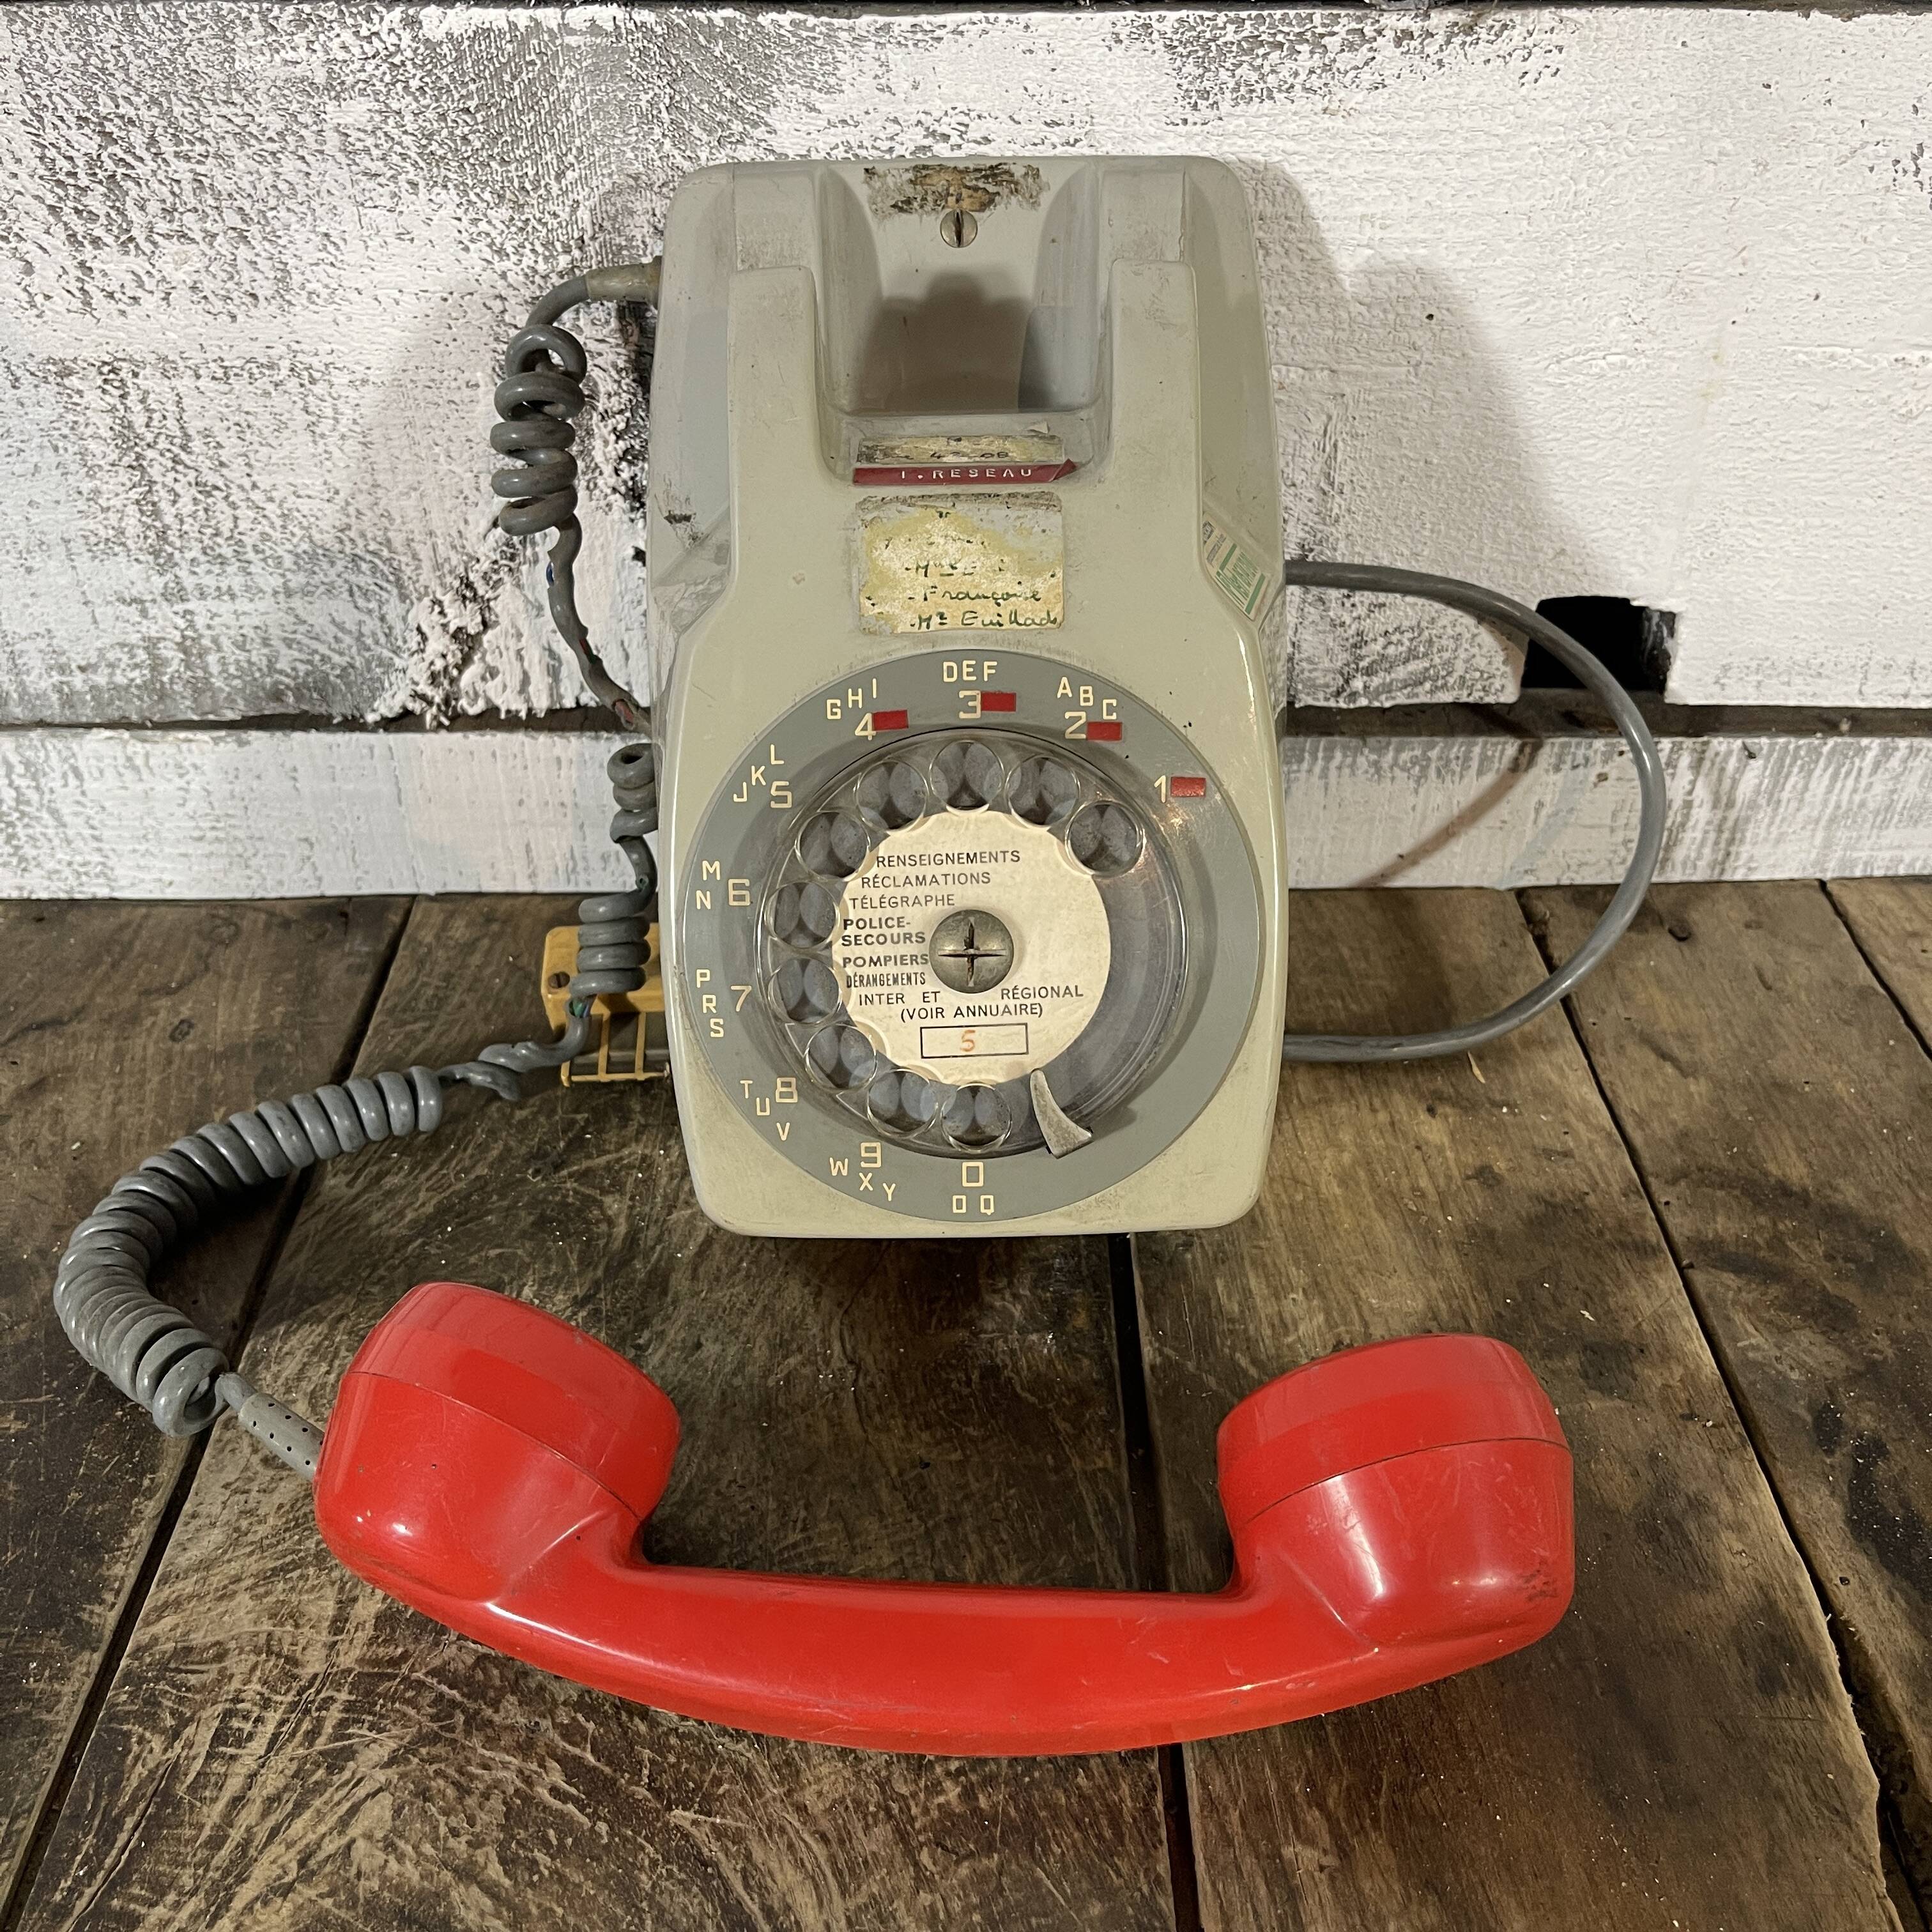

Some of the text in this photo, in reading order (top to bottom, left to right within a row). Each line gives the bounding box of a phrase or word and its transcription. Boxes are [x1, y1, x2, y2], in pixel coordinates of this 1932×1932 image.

[933, 468, 1031, 479] RESEAU
[958, 689, 982, 719] 3
[854, 712, 877, 740] 4
[1064, 710, 1087, 740] 2
[770, 781, 792, 808] 5
[1153, 774, 1167, 803] 1
[877, 850, 1022, 868] RENSEIGNEMENTS
[861, 871, 992, 889] RÉCLAMATIONS
[728, 878, 751, 906] 6
[849, 894, 956, 910] TÉLÉGRAPHE
[843, 916, 911, 930] POLICE-
[841, 931, 926, 946] SECOURS
[842, 953, 929, 968] POMPIERS
[845, 972, 926, 988] DÉRANGEMENTS
[730, 985, 752, 1012] 7
[859, 985, 1084, 1006] INTER ET RÉGIONAL
[900, 1003, 1043, 1023] (VOIR ANNUAIRE)
[960, 1029, 976, 1052] 5
[775, 1077, 798, 1103] 8
[860, 1142, 882, 1168] 9
[962, 1162, 984, 1187] 0
